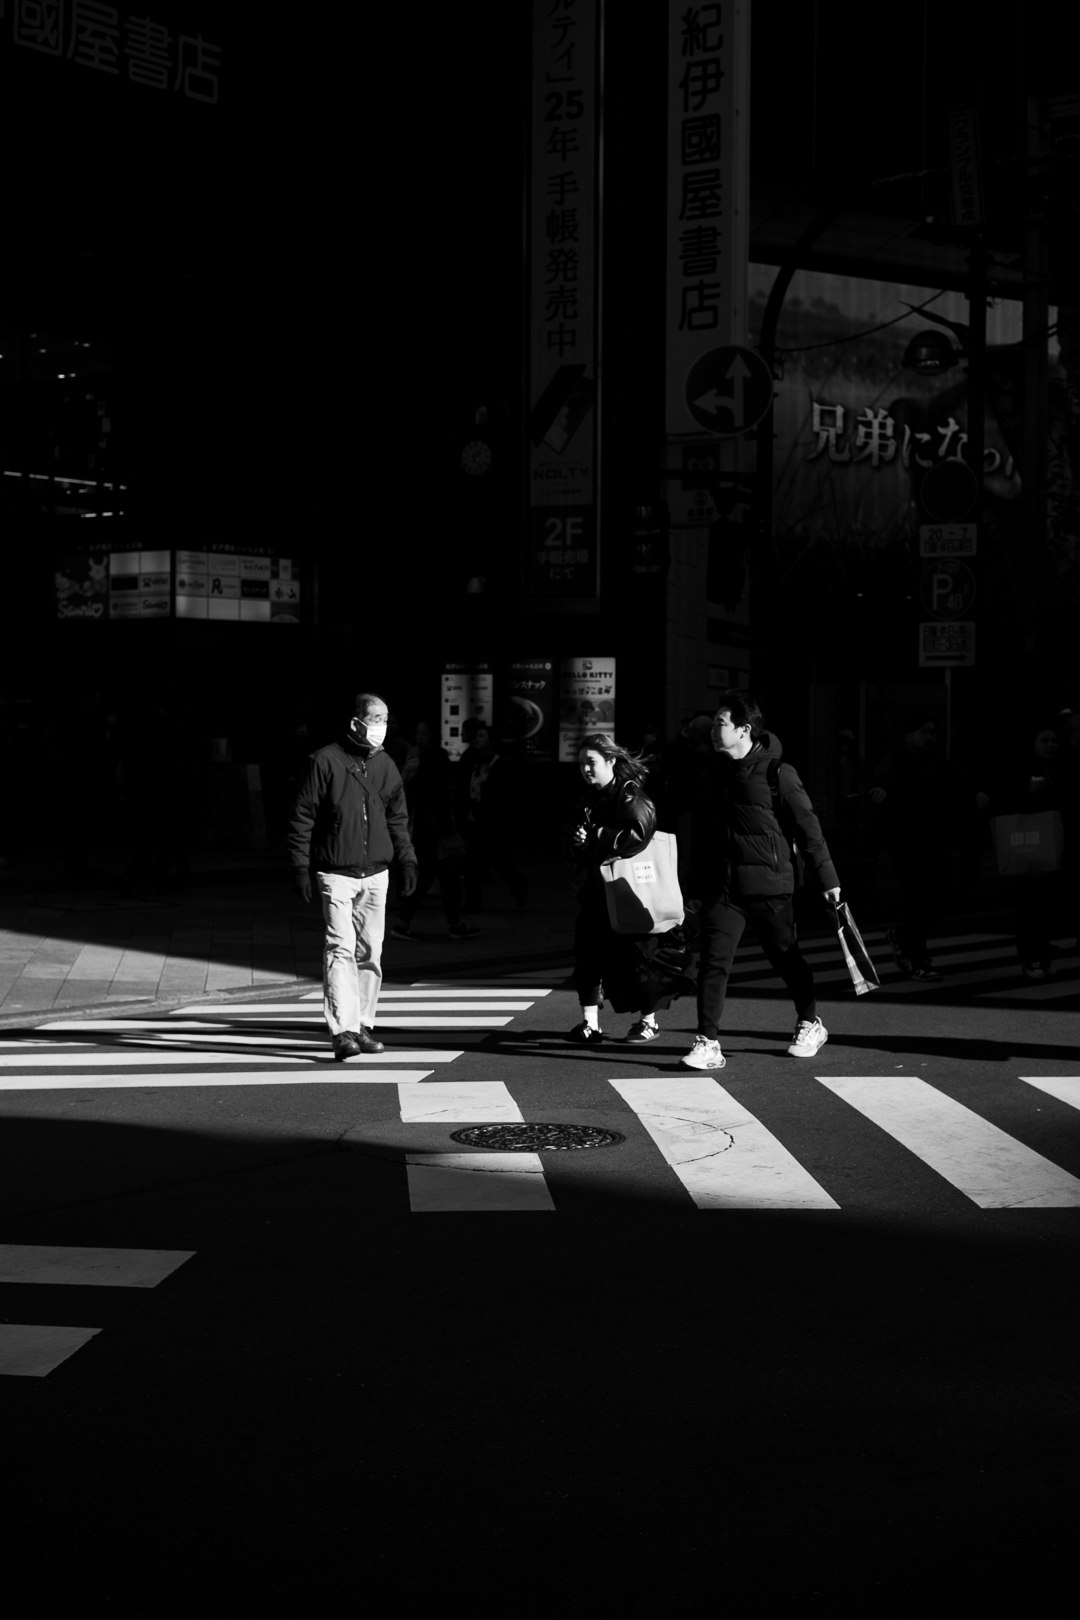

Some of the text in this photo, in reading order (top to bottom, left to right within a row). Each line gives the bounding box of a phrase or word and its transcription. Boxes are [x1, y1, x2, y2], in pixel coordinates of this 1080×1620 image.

[0, 0, 222, 104] 國屋書店
[679, 3, 724, 331] 紀伊國屋書店
[533, 466, 589, 480] NOLTY
[544, 516, 584, 546] 2F
[932, 573, 953, 611] P
